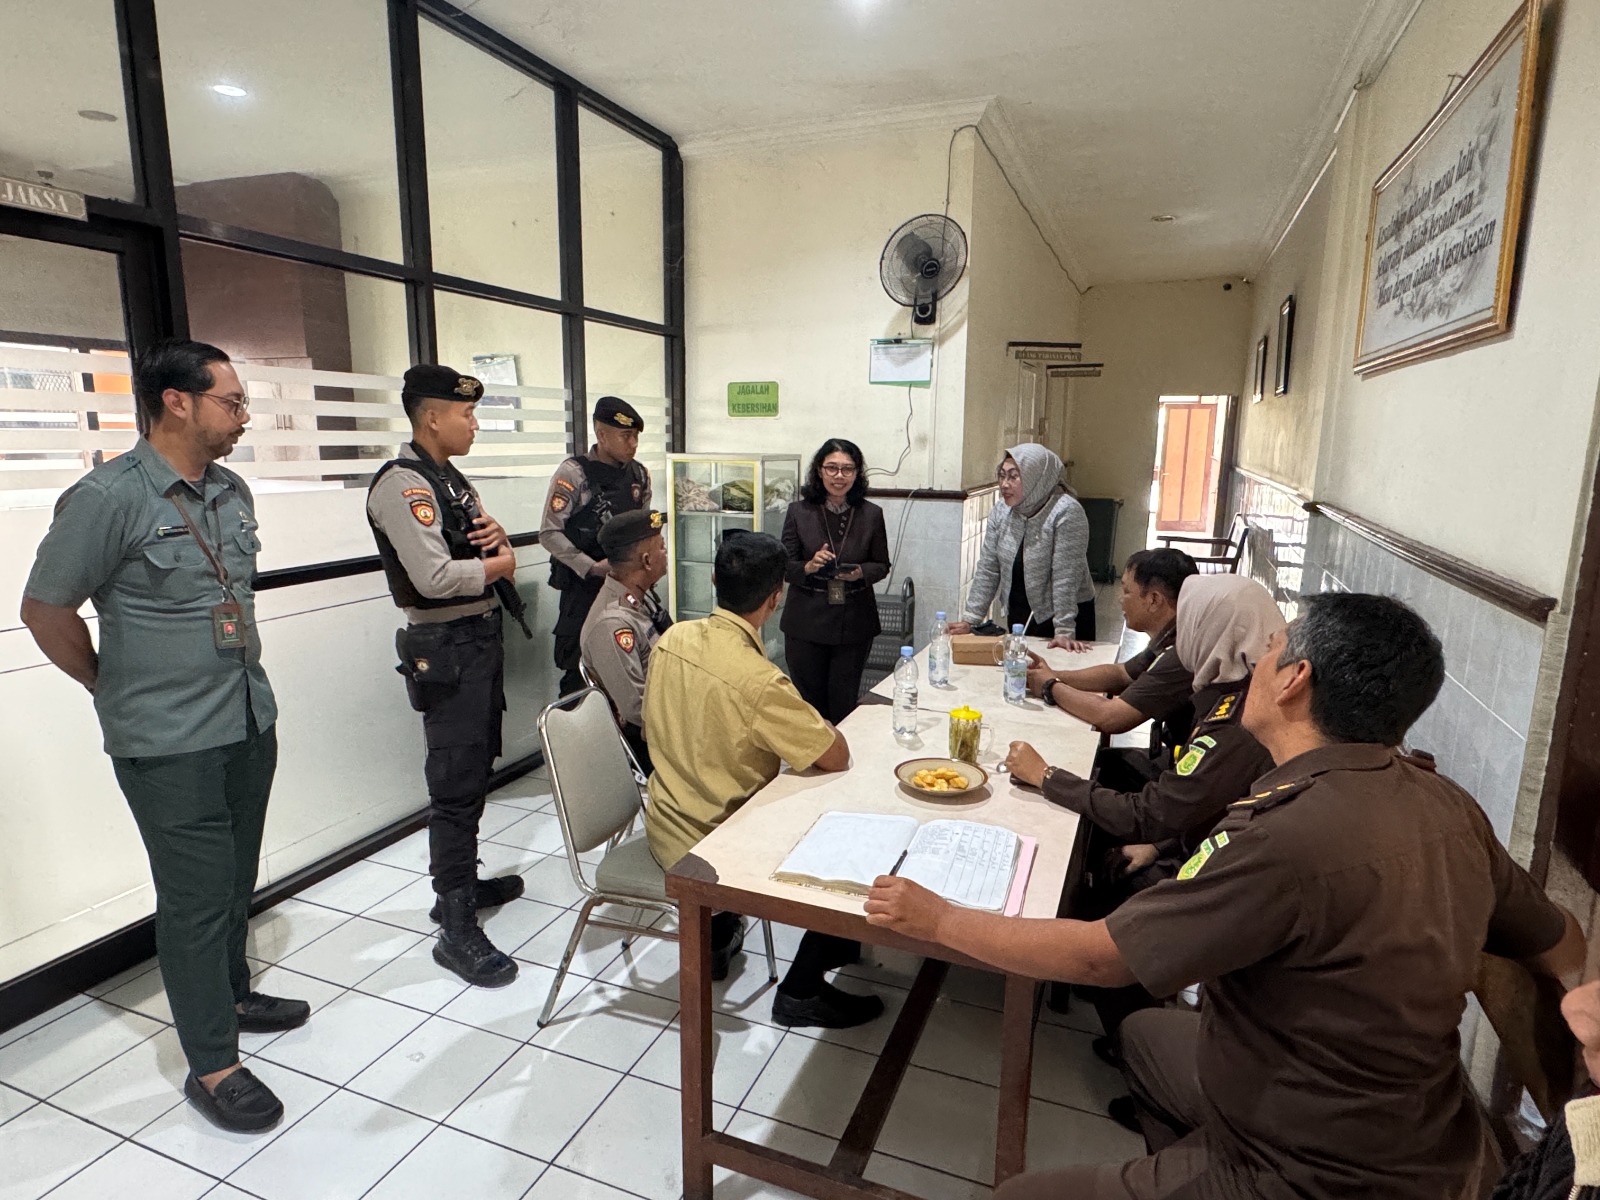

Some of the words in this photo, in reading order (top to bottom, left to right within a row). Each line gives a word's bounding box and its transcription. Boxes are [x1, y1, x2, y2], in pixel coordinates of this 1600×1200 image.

[1455, 141, 1475, 183] lalu
[1, 182, 69, 213] JAKSA
[1427, 190, 1475, 242] kesadaran
[1413, 247, 1440, 288] adalah
[1439, 218, 1497, 276] kesuksesan
[731, 402, 778, 413] KEBERSIHAN
[737, 384, 770, 395] JAGALAH
